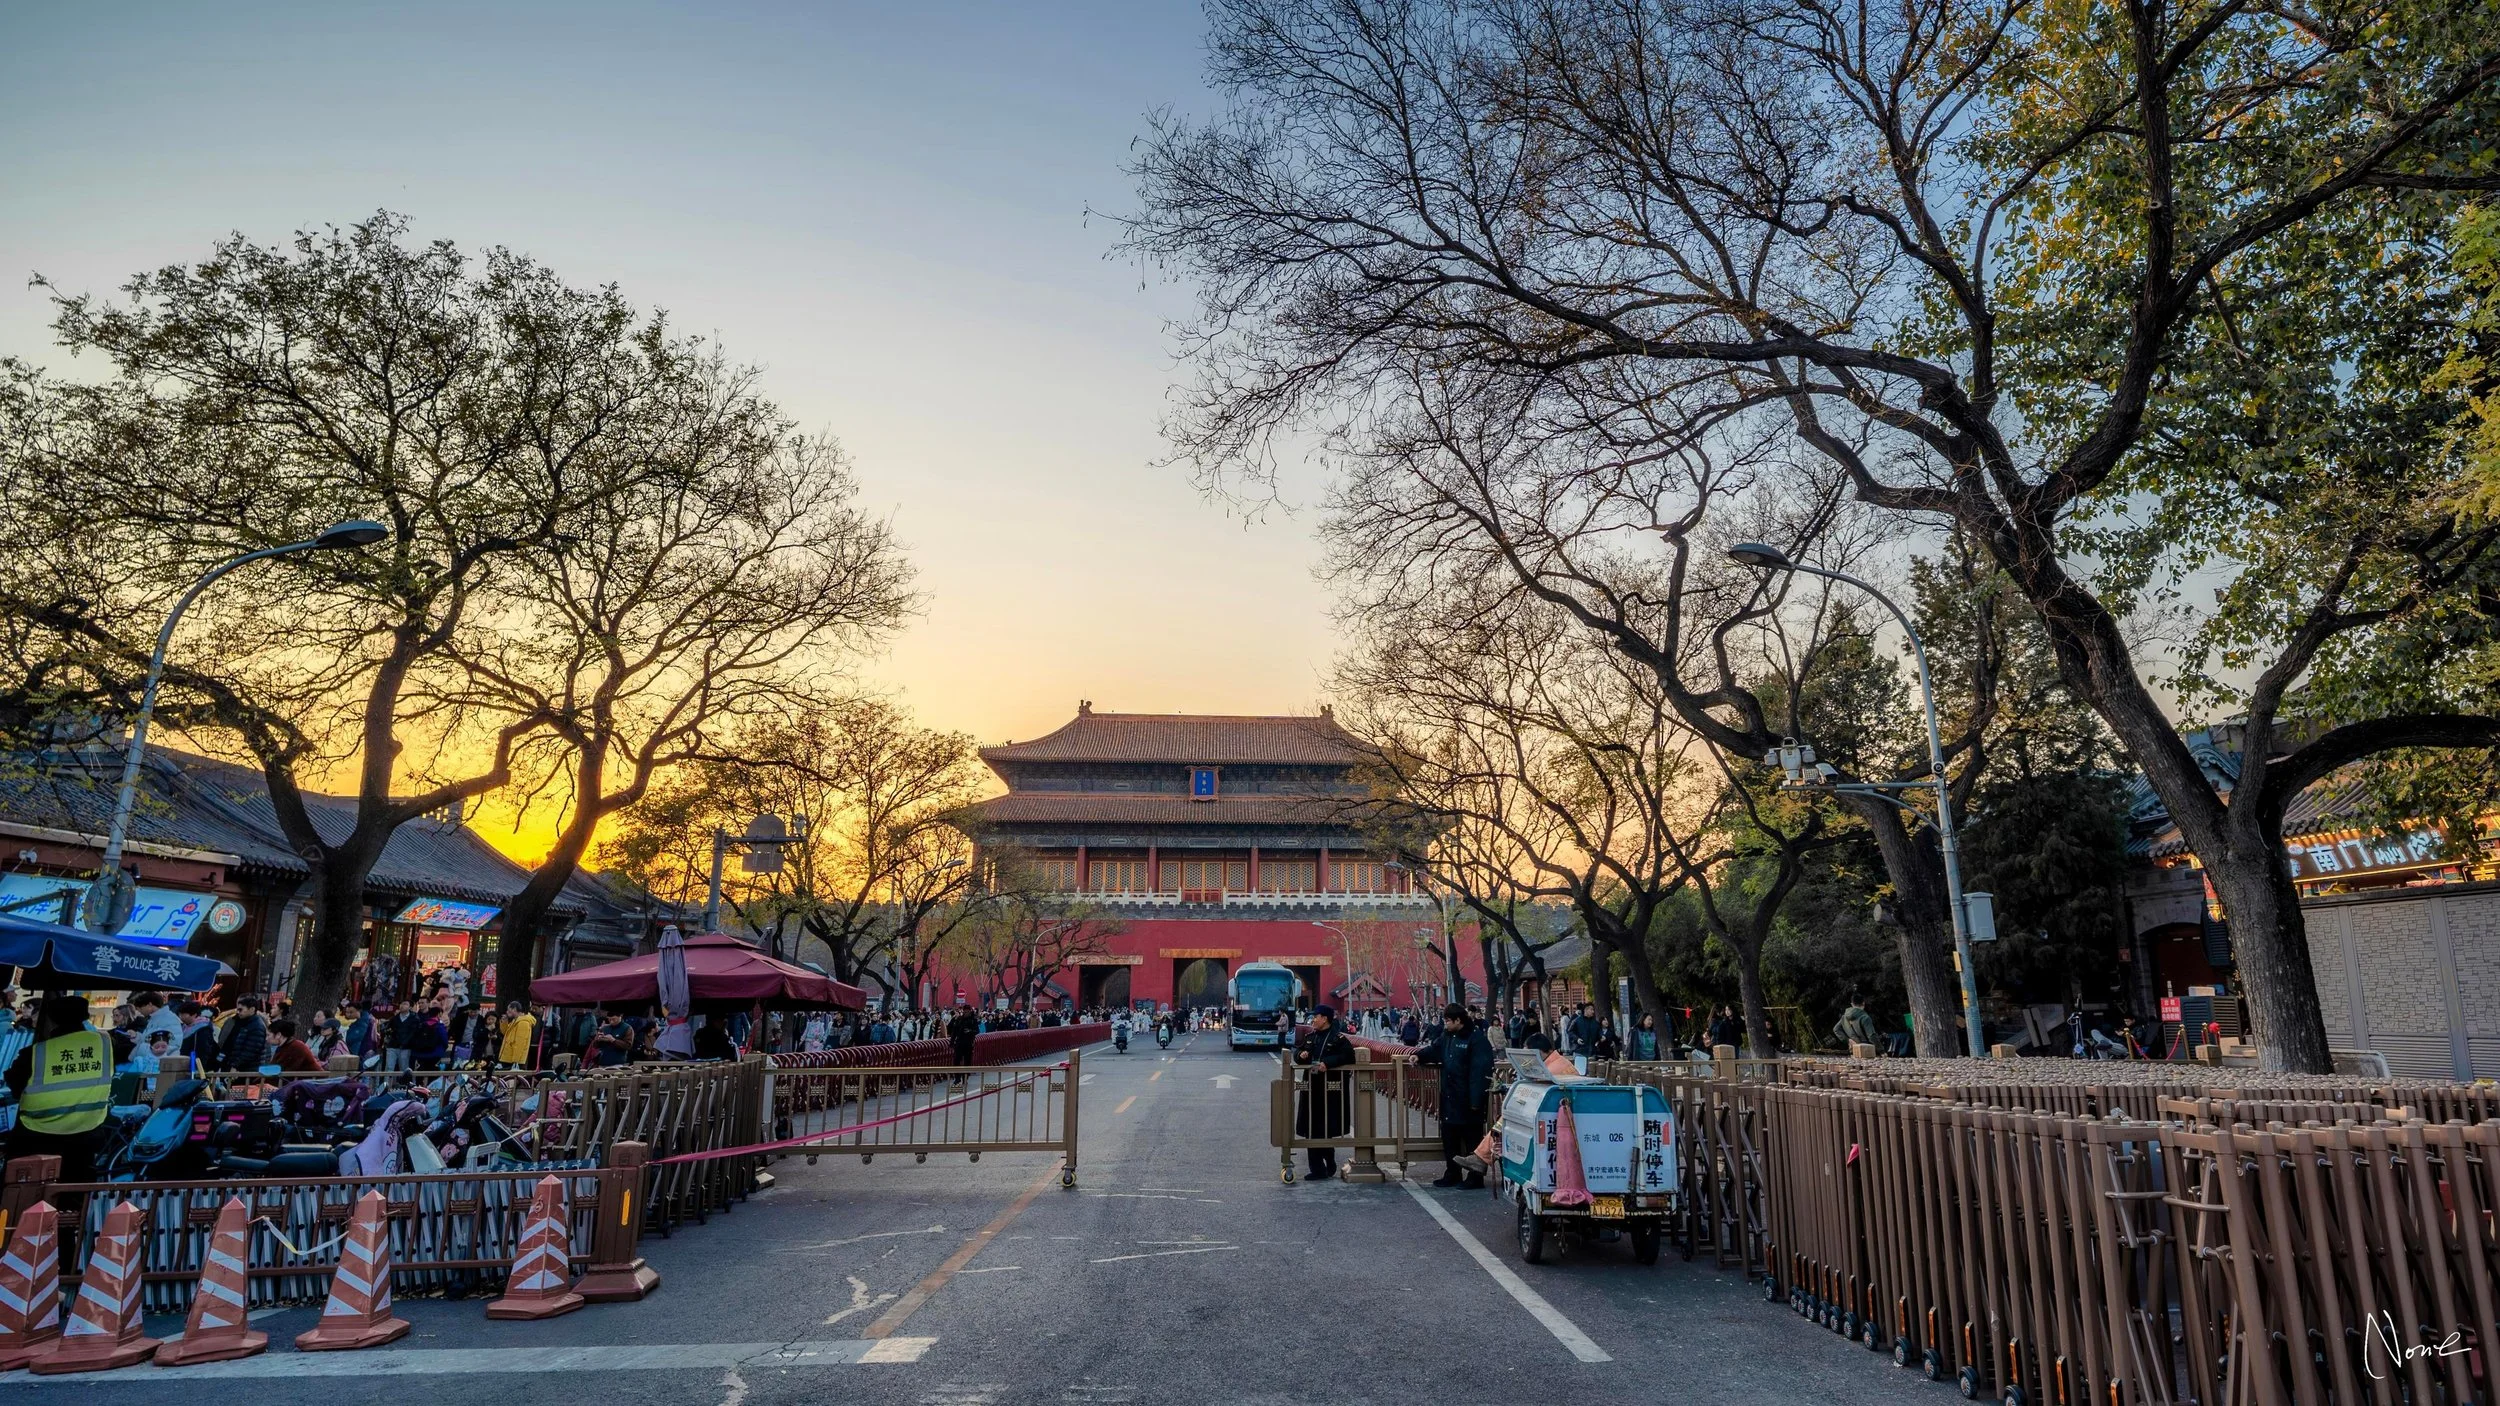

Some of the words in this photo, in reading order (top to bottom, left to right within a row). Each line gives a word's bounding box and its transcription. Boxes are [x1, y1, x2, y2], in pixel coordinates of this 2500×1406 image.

[92, 945, 122, 973] 警
[123, 956, 154, 972] POLICE
[154, 956, 181, 982] 察
[51, 1060, 102, 1077] 警保联动
[1608, 1132, 1624, 1142] 026
[1643, 1119, 1664, 1188] 随时停车
